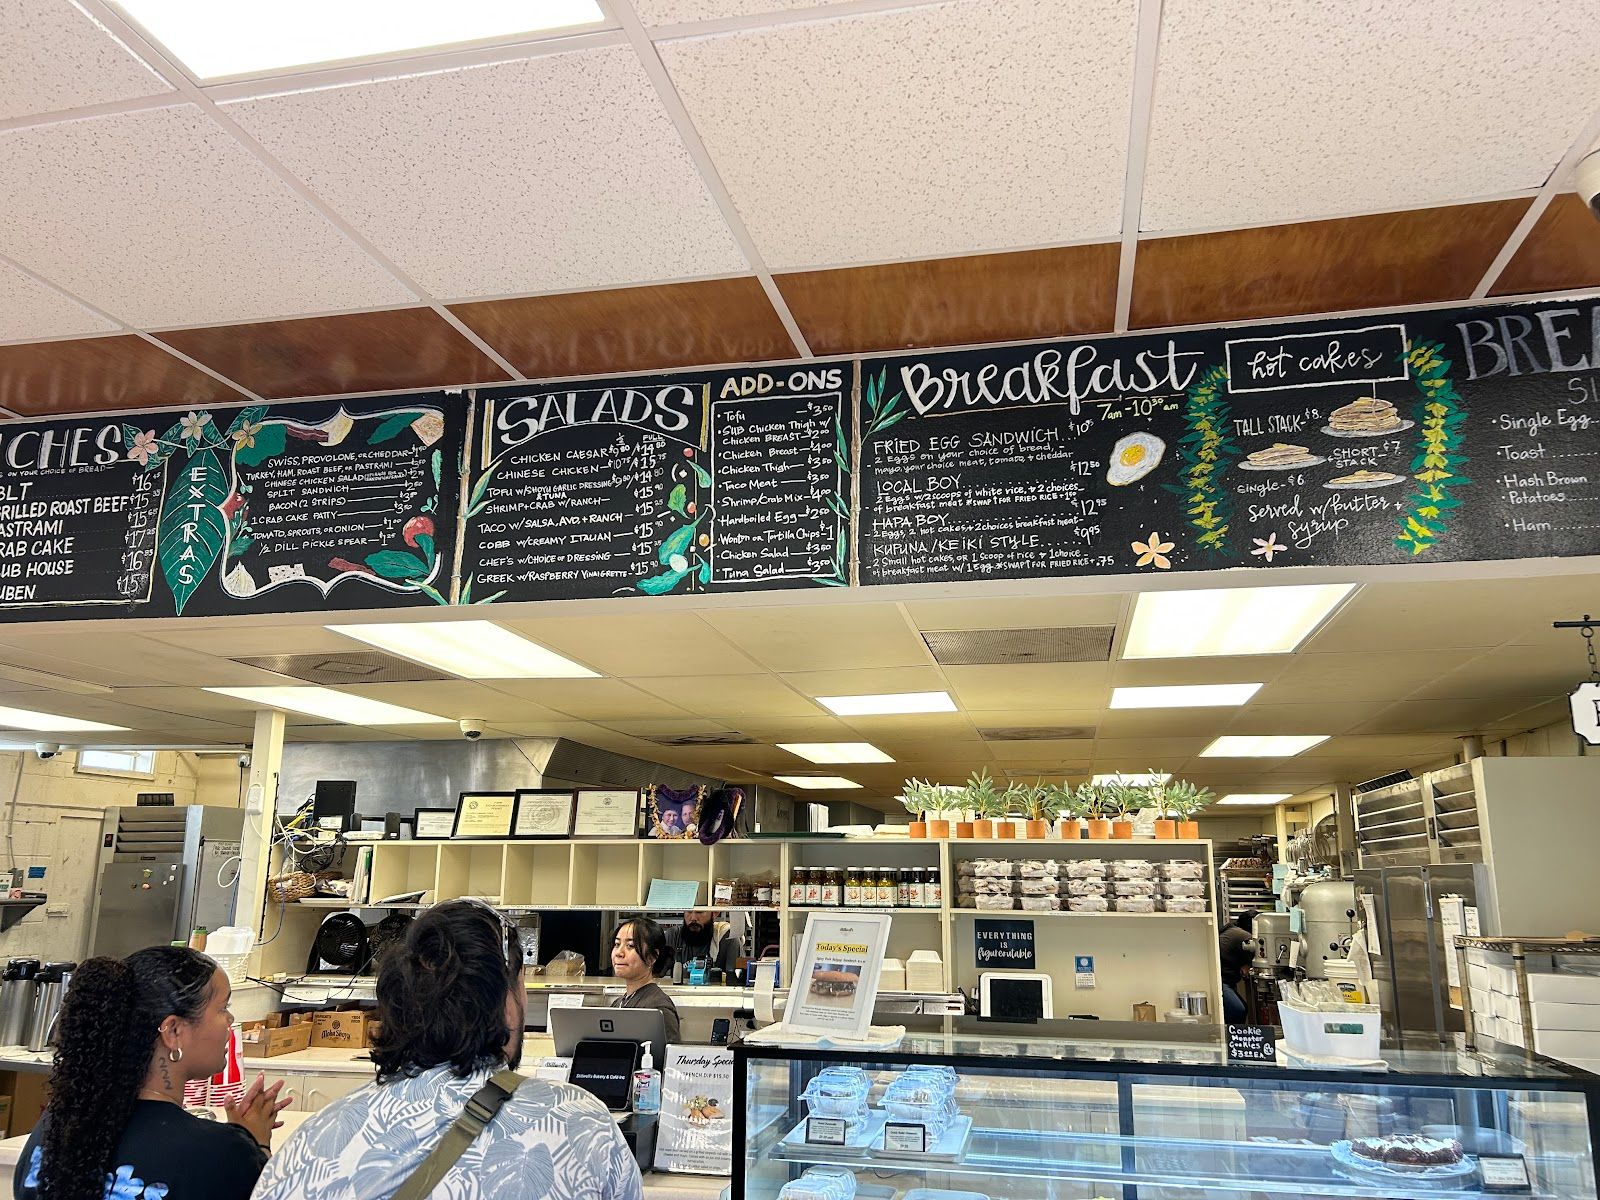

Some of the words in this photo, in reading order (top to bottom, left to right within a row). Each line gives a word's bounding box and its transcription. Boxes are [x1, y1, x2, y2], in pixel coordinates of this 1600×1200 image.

[1455, 305, 1600, 381] BRE
[1248, 346, 1293, 379] hot
[1299, 340, 1382, 373] cakes
[720, 369, 842, 398] ADD-ONS
[900, 340, 1204, 415] Breakfast
[497, 386, 694, 444] SALADS
[723, 410, 745, 423] Tofu
[1500, 412, 1551, 436] Single
[1558, 409, 1591, 431] Egg
[722, 425, 745, 436] SUB
[748, 423, 786, 434] Chicken
[788, 419, 816, 433] Thigh
[1234, 419, 1263, 436] TALL
[1268, 414, 1301, 434] STACK
[722, 436, 760, 445] Chicken
[764, 432, 801, 443] BREAST
[873, 438, 921, 455] FRIED
[929, 435, 960, 451] EGG
[968, 426, 1059, 447] SANDWICH
[0, 424, 121, 469] CHES
[722, 450, 762, 460] Chicken
[768, 447, 799, 457] Breast
[1333, 446, 1378, 458] SHORT
[1500, 443, 1547, 461] Toast
[510, 453, 561, 465] CHICKEN
[566, 448, 609, 460] CAESAR
[887, 454, 915, 464] Eggs
[938, 451, 964, 462] your
[969, 447, 998, 457] choice
[1003, 445, 1015, 455] of
[926, 460, 955, 470] choice
[1036, 451, 1074, 461] cheddar
[297, 466, 321, 476] ROAST
[355, 462, 393, 471] PASTRAMI
[721, 465, 760, 475] Chicken
[761, 461, 790, 473] Thigh
[1335, 457, 1378, 468] STACK
[299, 475, 335, 485] CHICKEN
[337, 473, 364, 483] SALAD
[496, 468, 546, 480] CHINESE
[552, 464, 599, 476] CHICKEN
[1504, 473, 1544, 488] Hash
[1547, 471, 1587, 486] Brown
[267, 488, 295, 499] SPLIT
[301, 484, 349, 496] SANDWICH
[486, 488, 513, 498] TOFU
[553, 483, 577, 493] GARLIC
[579, 480, 612, 490] DRESSING
[721, 480, 747, 491] Taco
[749, 479, 778, 490] Meat
[877, 478, 922, 496] LOCAL
[926, 473, 961, 492] BOY
[975, 487, 1002, 497] white
[1046, 481, 1079, 493] choices
[784, 493, 803, 501] Mix
[1014, 494, 1037, 503] FRIED
[1039, 492, 1058, 501] RICE
[1509, 490, 1565, 504] Potatoes
[50, 498, 91, 517] ROAST
[93, 495, 128, 513] BEEF
[269, 501, 298, 512] BACON
[885, 500, 936, 513] breakfast
[939, 498, 964, 508] meat
[178, 466, 207, 584] EXTRAS
[285, 513, 308, 522] CAKE
[478, 523, 506, 534] TACO
[589, 512, 623, 524] RANCH
[719, 511, 771, 526] Hardboiled
[774, 511, 797, 524] Egg
[872, 516, 913, 531] HAPA
[915, 512, 950, 527] BOY
[1015, 517, 1056, 529] breakfast
[1057, 515, 1079, 527] meat
[1513, 518, 1551, 532] Ham
[334, 524, 365, 533] ONION
[1288, 518, 1349, 548] syrup
[479, 541, 511, 550] COBB
[570, 532, 612, 544] ITALIAN
[719, 533, 750, 545] Wonton
[763, 529, 795, 543] Tortilla
[795, 528, 820, 540] Chips
[990, 534, 1040, 550] STYLE
[31, 537, 75, 555] CAKE
[274, 541, 299, 552] DILL
[302, 538, 335, 549] PICKLE
[337, 537, 367, 546] SPEAR
[479, 557, 514, 567] CHEF'S
[567, 551, 611, 563] DRESSING
[721, 550, 757, 560] Chicken
[760, 546, 789, 559] Salad
[26, 560, 74, 578] HOUSE
[881, 557, 907, 567] Small
[1049, 560, 1071, 569] FRIED
[477, 573, 515, 584] GREEK
[722, 568, 749, 580] Tuna
[753, 562, 784, 577] Salad
[977, 931, 1032, 940] EVERYTHING
[816, 943, 842, 953] Today's
[843, 944, 869, 954] Special
[1000, 941, 1008, 949] IS
[1228, 1025, 1262, 1035] Cookie
[1229, 1041, 1261, 1049] Cookies
[676, 1055, 711, 1068] Thursday
